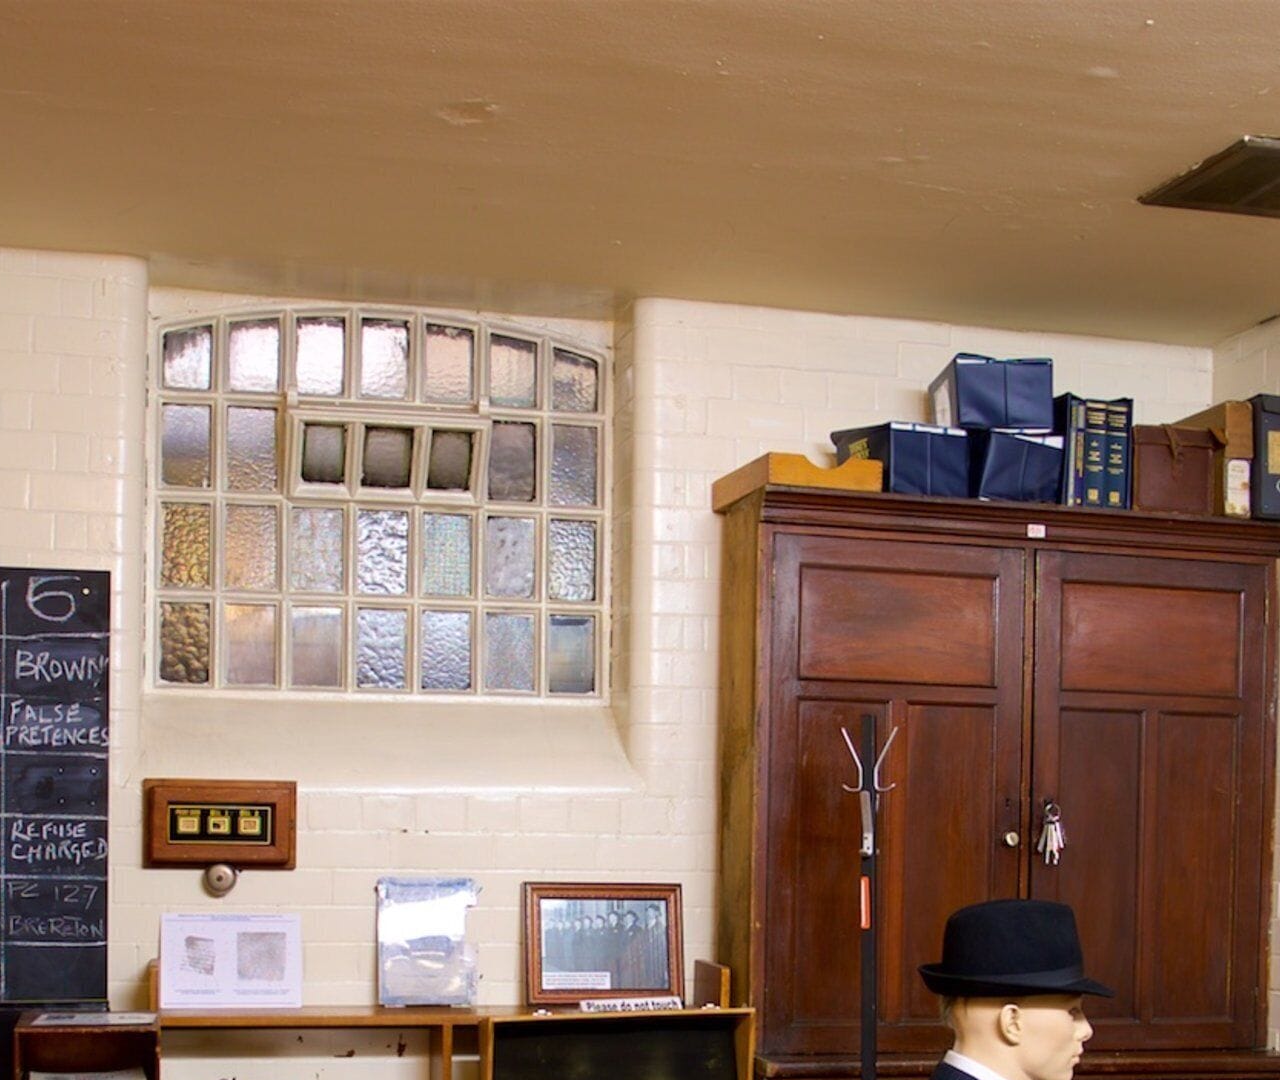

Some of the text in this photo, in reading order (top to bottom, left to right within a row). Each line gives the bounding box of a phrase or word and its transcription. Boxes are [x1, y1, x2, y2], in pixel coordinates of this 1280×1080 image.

[26, 575, 81, 622] 6
[14, 649, 110, 684] BROWN
[10, 699, 83, 724] FALSE
[6, 725, 110, 748] PRETENCES
[10, 821, 89, 842] REFUSE
[9, 841, 108, 866] CHARGED
[585, 1002, 618, 1012] Please
[620, 1001, 631, 1012] do
[634, 1001, 649, 1011] not
